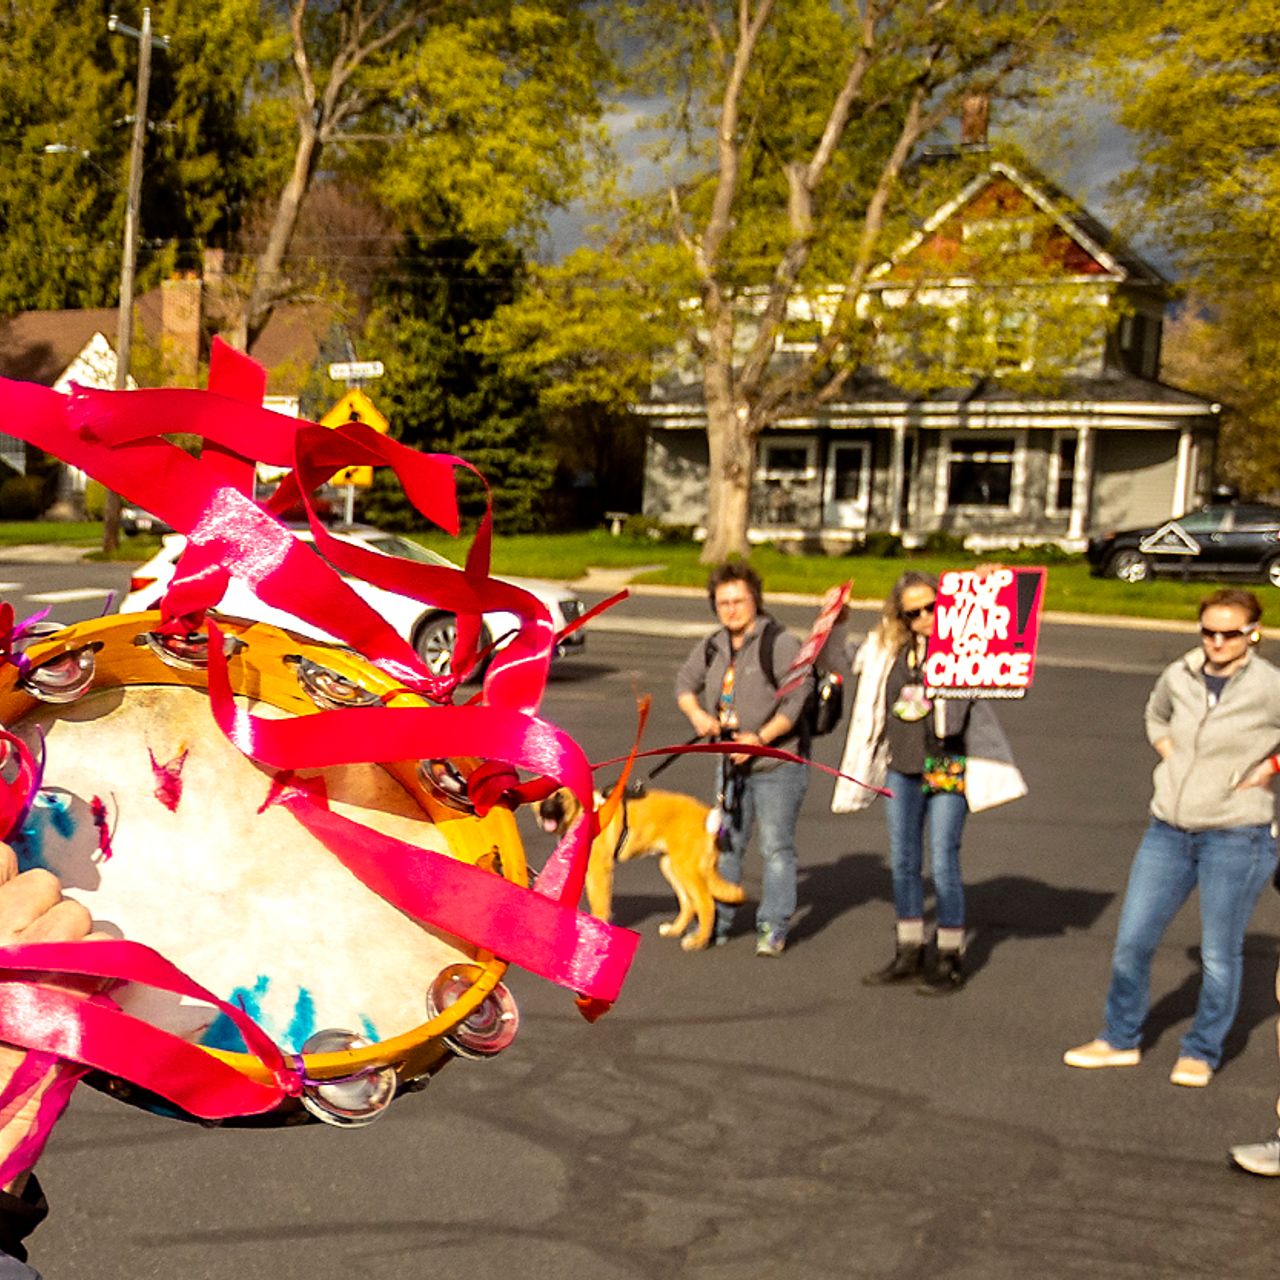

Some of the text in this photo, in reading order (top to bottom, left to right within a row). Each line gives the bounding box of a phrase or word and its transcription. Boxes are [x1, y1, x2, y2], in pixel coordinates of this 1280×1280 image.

[940, 569, 1014, 596] STOP
[937, 604, 1011, 640] WAR
[926, 651, 1032, 687] CHOICE
